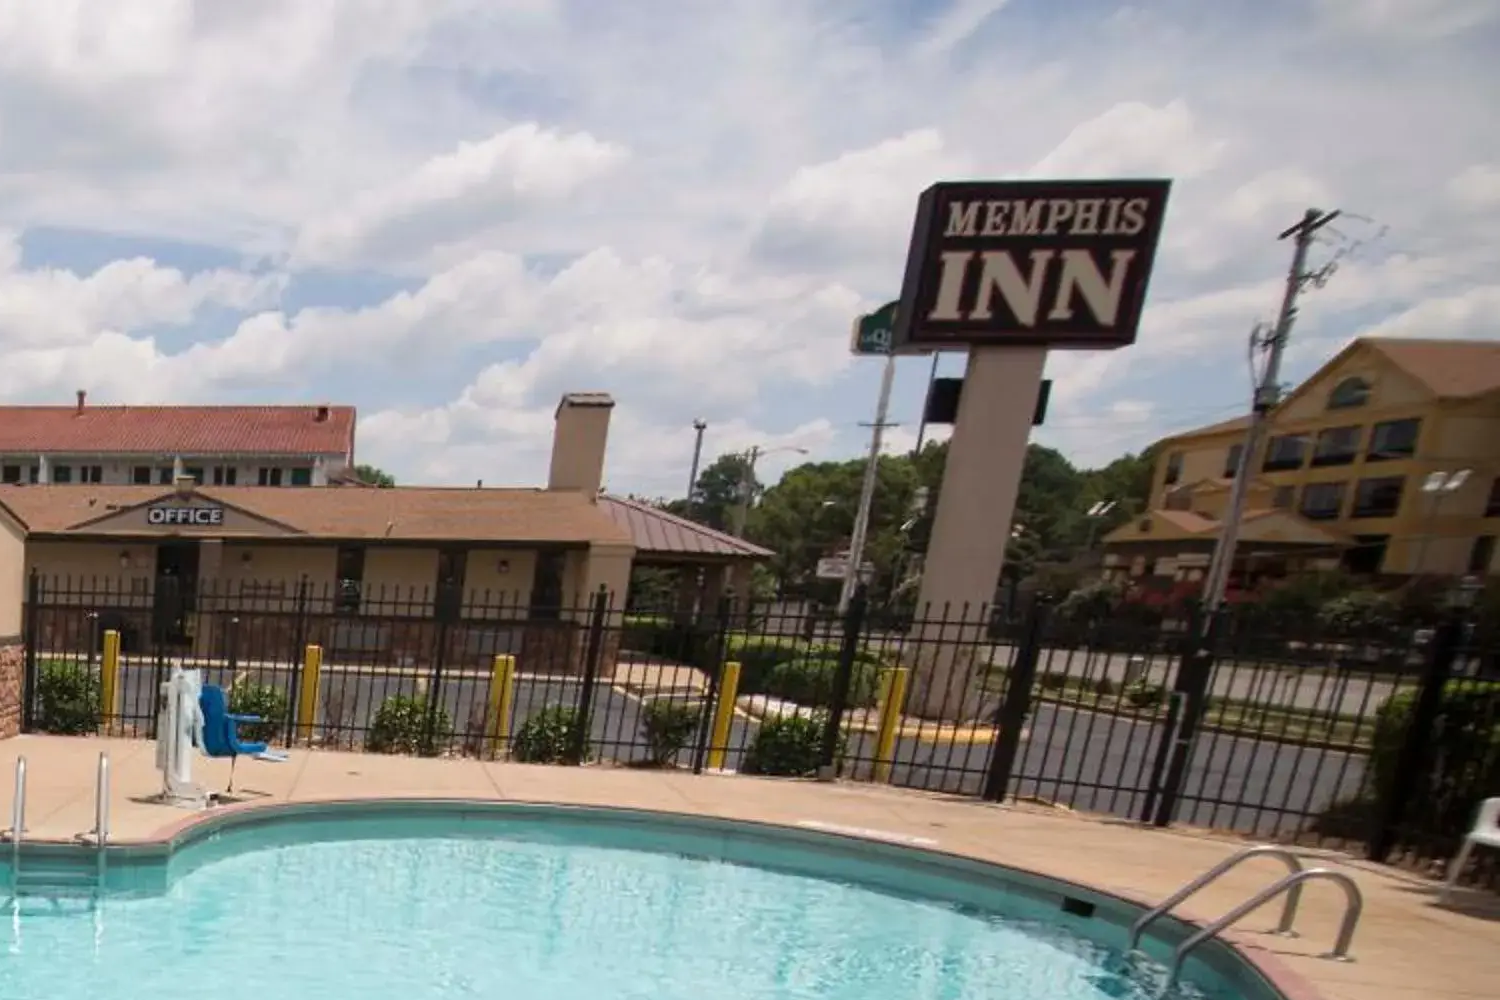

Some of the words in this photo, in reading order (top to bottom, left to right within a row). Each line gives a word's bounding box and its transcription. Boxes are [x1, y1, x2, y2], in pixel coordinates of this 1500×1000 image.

[943, 197, 1149, 237] MEMPHIS
[927, 249, 1137, 327] INN
[149, 508, 223, 523] OFFICE
